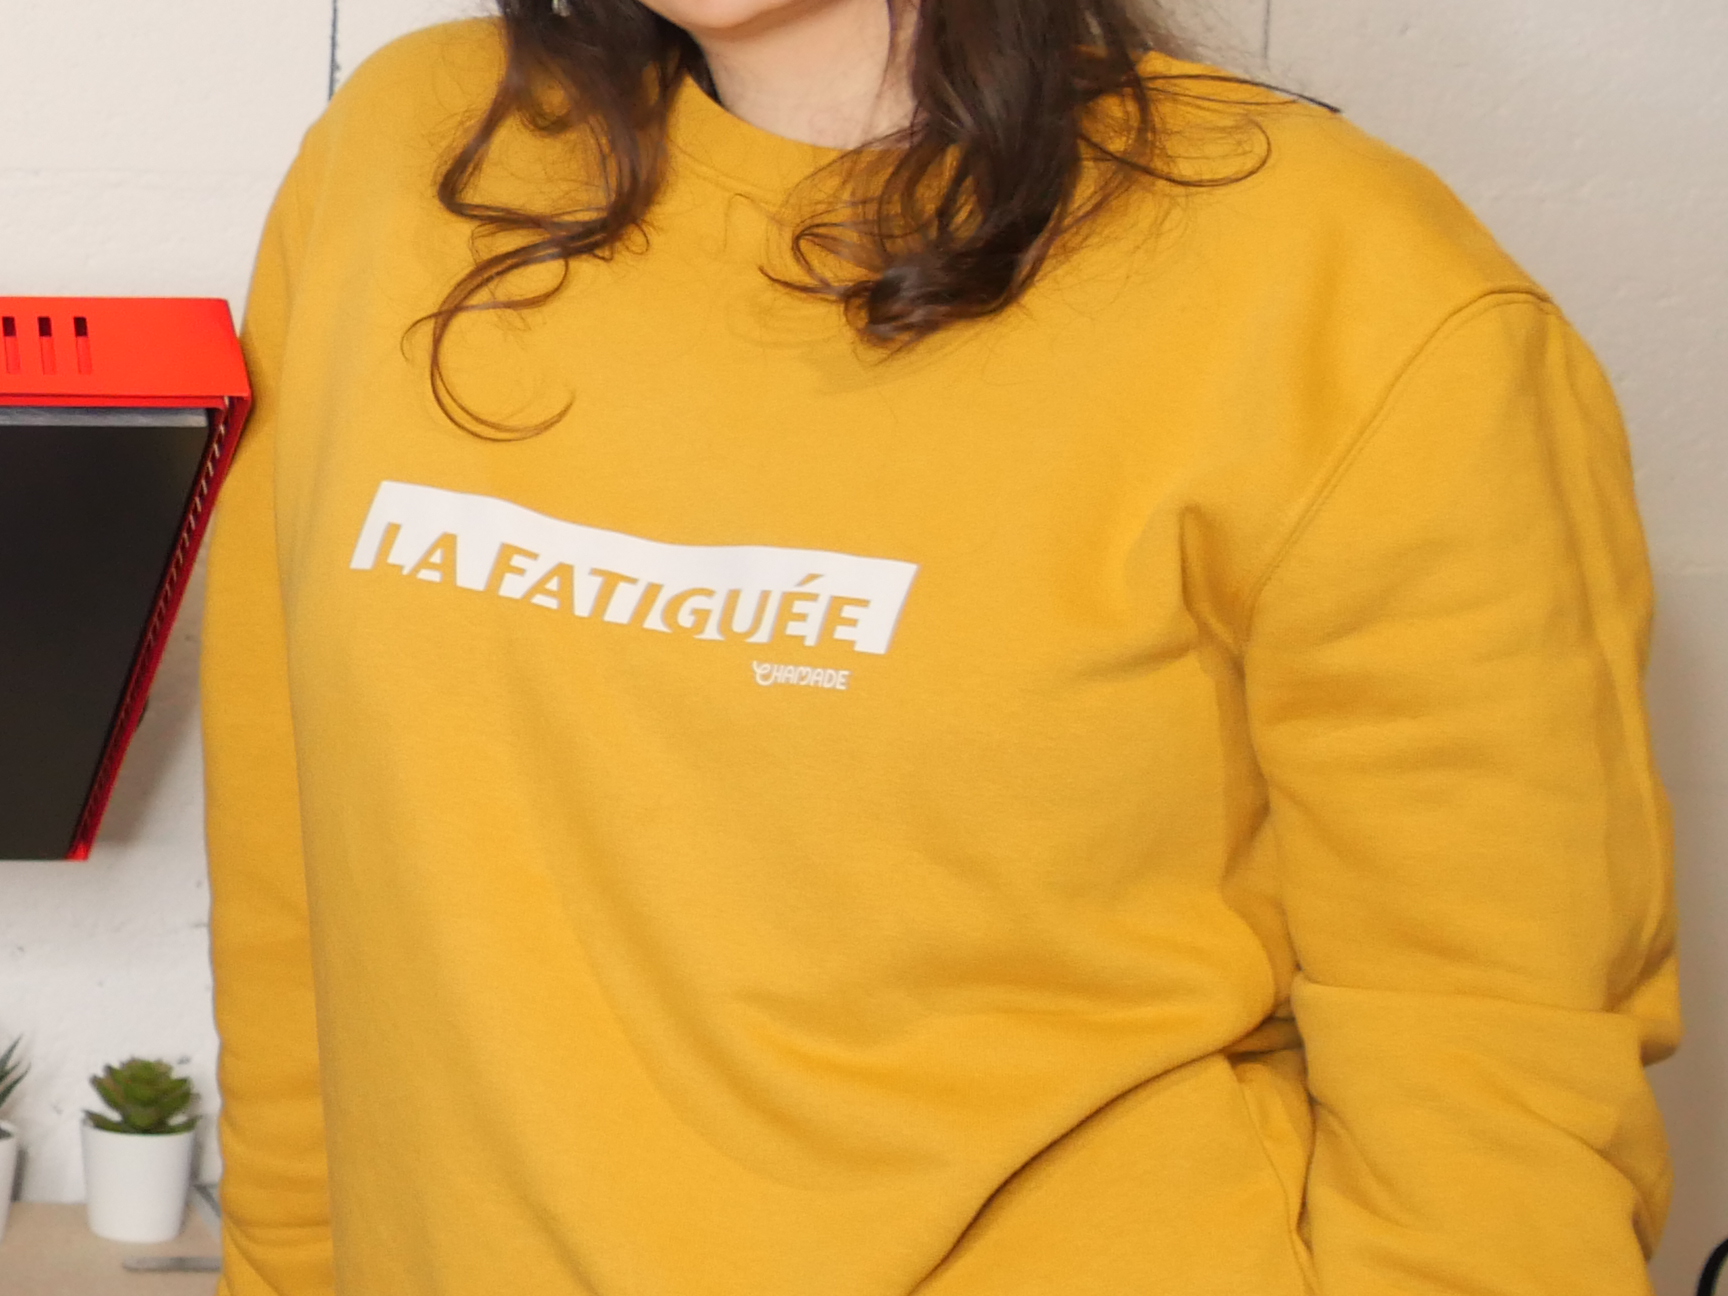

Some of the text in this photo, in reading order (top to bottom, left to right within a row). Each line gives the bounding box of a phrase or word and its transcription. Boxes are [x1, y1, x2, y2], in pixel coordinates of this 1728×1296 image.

[370, 520, 872, 653] LA FATIGUÉE
[751, 660, 850, 690] CHAMADE
